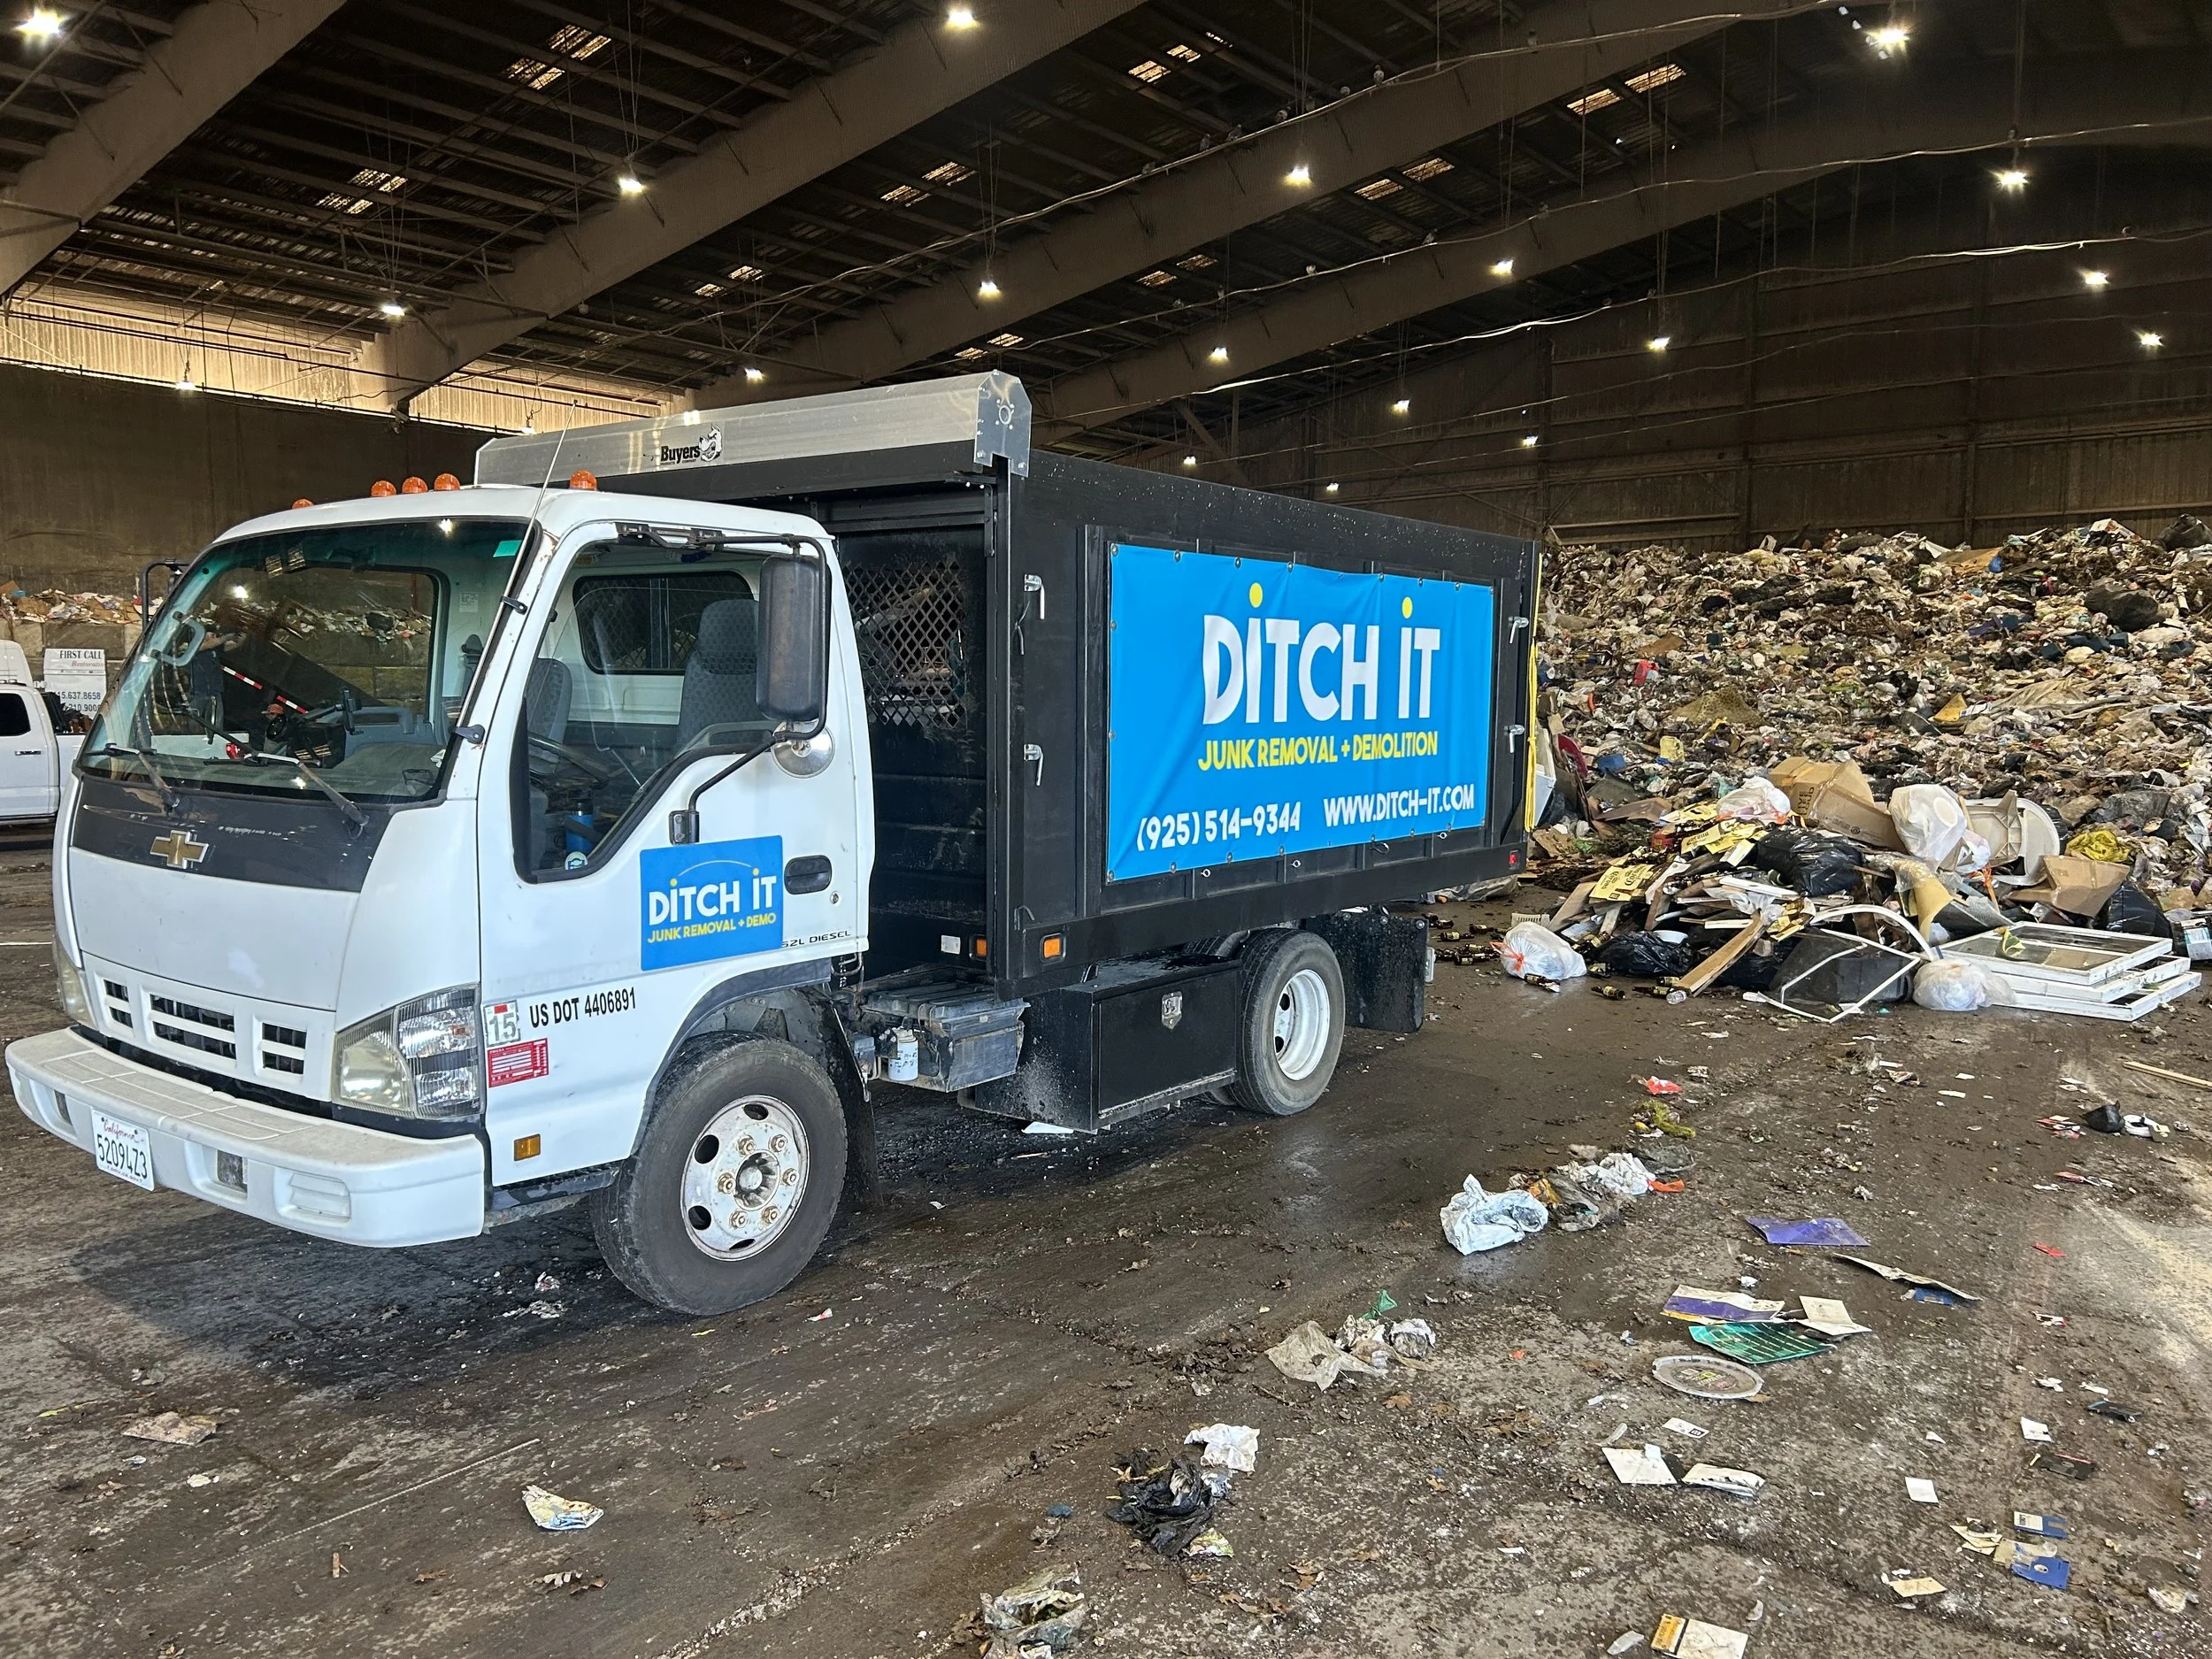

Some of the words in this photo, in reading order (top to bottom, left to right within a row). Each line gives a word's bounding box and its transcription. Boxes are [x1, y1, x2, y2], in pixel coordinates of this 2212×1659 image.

[660, 445, 701, 465] Buyers
[59, 649, 81, 659] FIRST
[83, 650, 103, 660] CALL
[1198, 739, 1255, 770] JUNK
[1257, 736, 1338, 767] REMOVAL
[1340, 743, 1351, 758] +
[1352, 731, 1438, 761] DEMOLITION
[1323, 784, 1475, 828] WWW.DITCH-IT.COM
[1136, 811, 1201, 851] (925)
[1205, 802, 1301, 842] 514-9344
[647, 926, 681, 944] JUNK
[683, 918, 736, 938] REMOVAL
[738, 918, 745, 927] +
[746, 912, 777, 928] DEMO
[809, 930, 851, 943] DIESEL
[529, 1002, 549, 1028] US
[552, 997, 580, 1025] DOT
[584, 987, 635, 1018] 4406891
[489, 1012, 517, 1041] 15
[104, 1118, 140, 1143] California
[96, 1133, 148, 1179] 52094Z3
